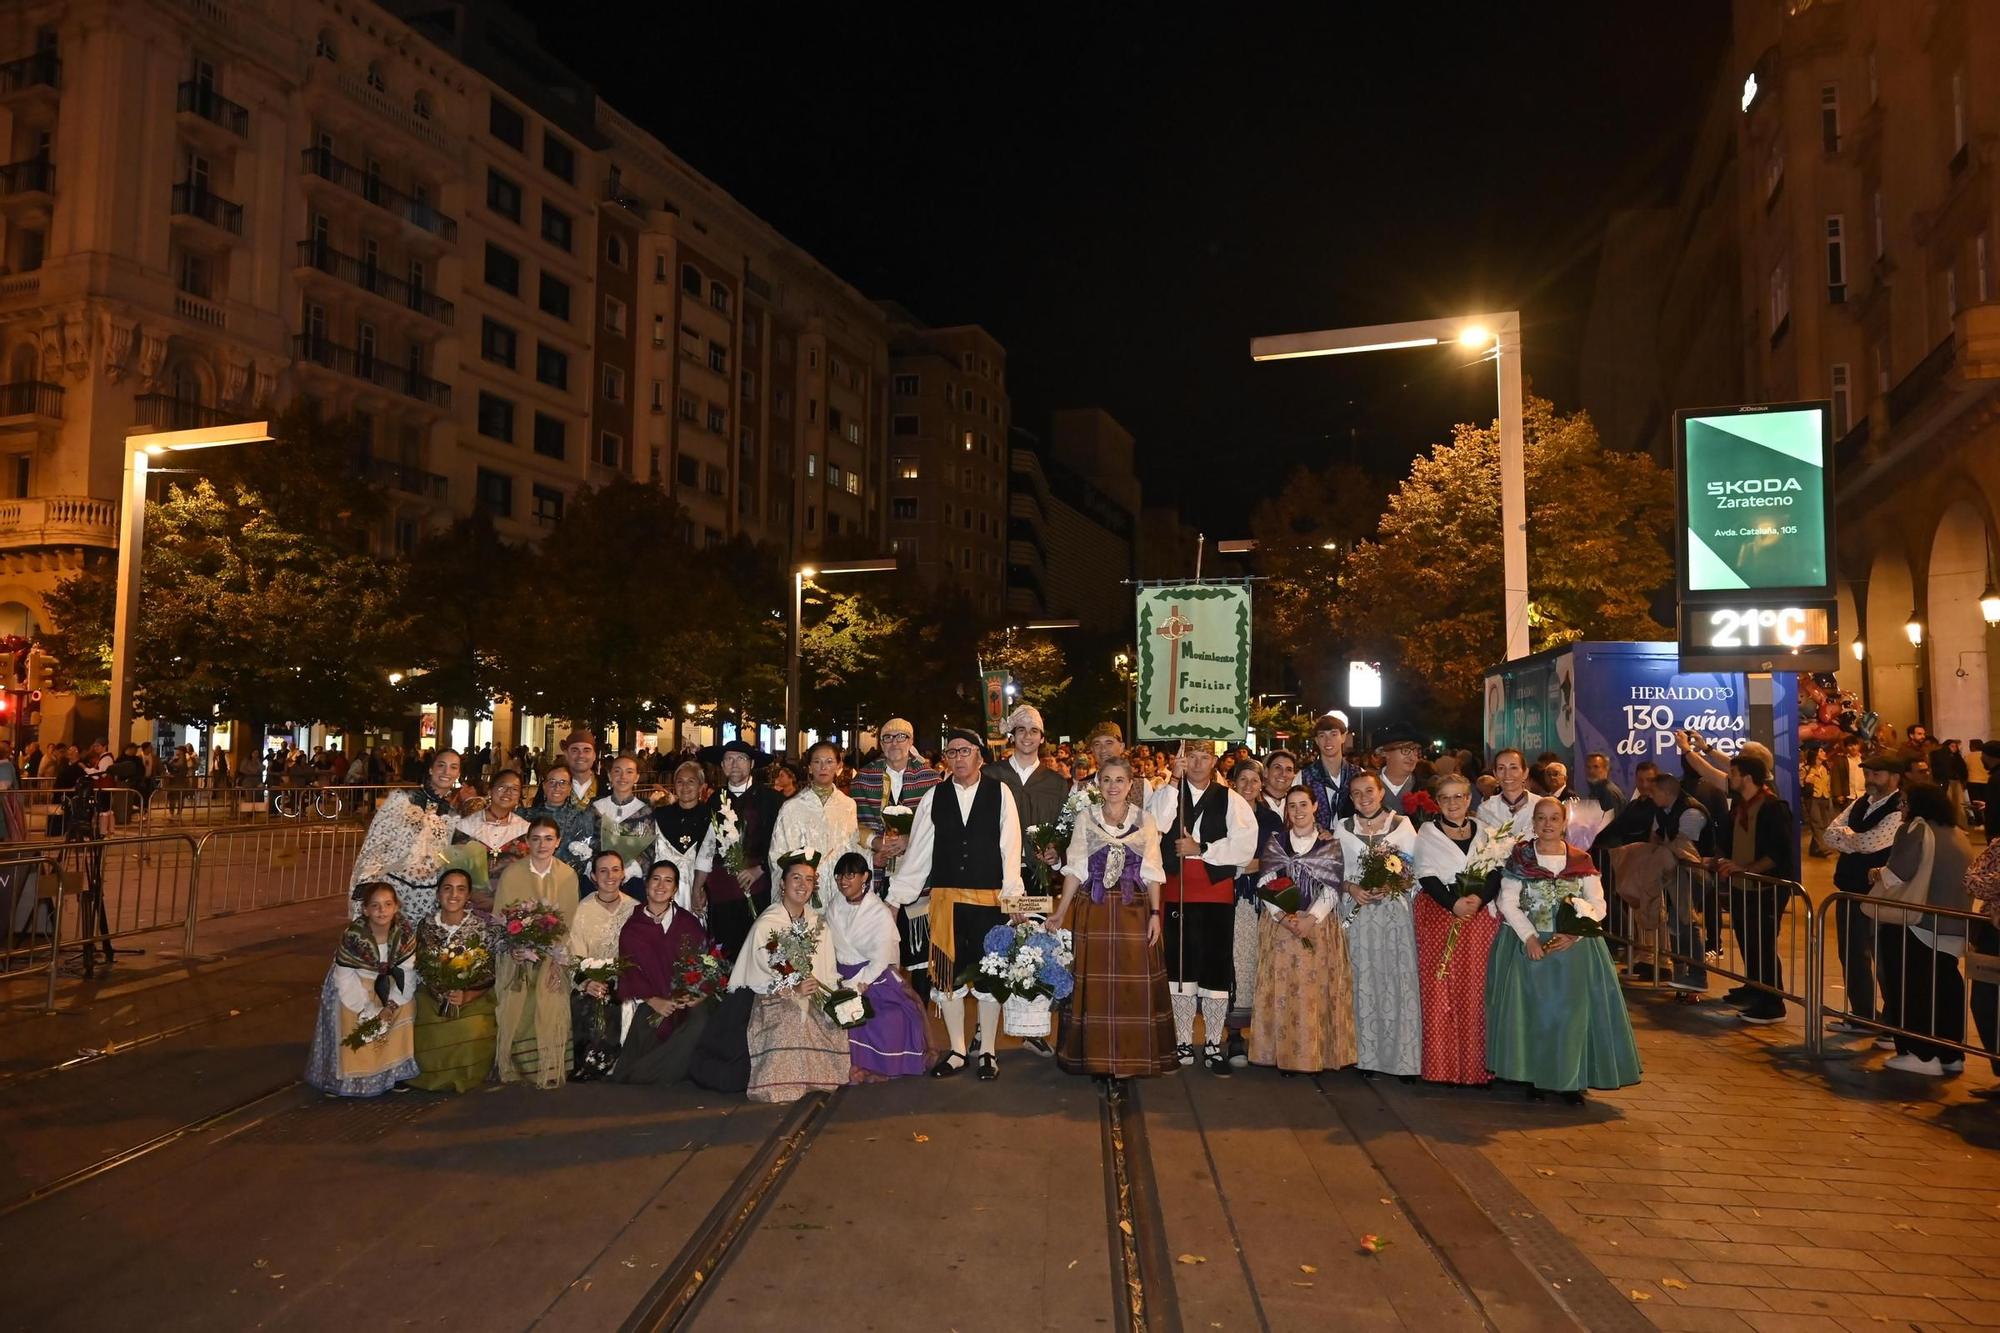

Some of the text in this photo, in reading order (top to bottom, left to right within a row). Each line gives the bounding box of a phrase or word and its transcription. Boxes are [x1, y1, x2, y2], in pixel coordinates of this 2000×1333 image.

[1716, 496, 1793, 509] Zaratecno
[1714, 525, 1798, 537] Avda. Cataluña, 105
[1181, 641, 1235, 663] Movimiento
[1180, 672, 1232, 690] Familiar
[1631, 686, 1714, 700] HERALDO
[1180, 697, 1235, 714] Cristiano
[1622, 704, 1745, 731] 130 años
[1616, 730, 1648, 755] de
